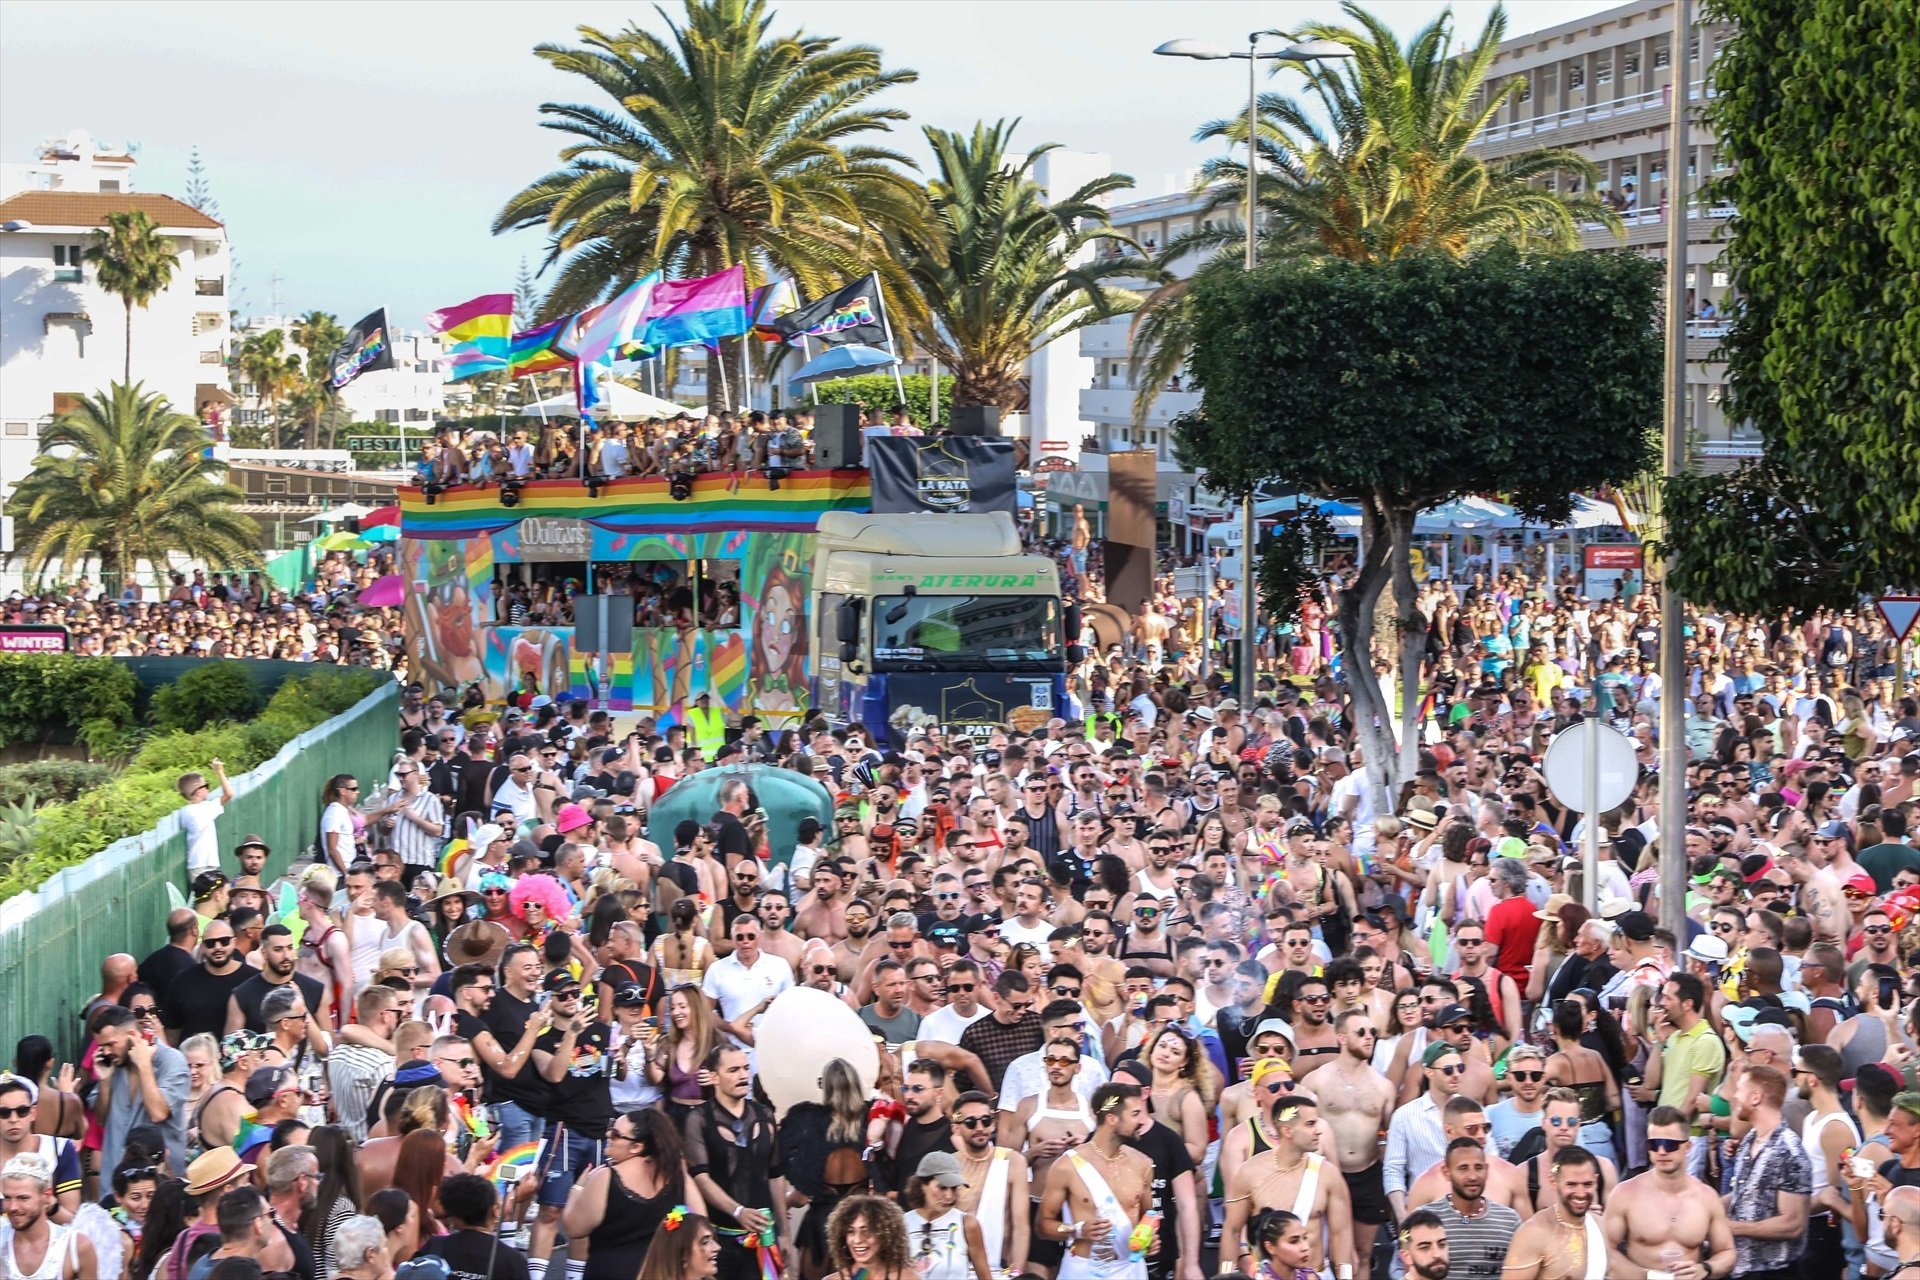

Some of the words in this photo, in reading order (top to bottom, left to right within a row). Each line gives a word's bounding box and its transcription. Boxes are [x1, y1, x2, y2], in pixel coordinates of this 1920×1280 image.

[918, 480, 935, 490] LA
[938, 480, 969, 490] PATA
[917, 574, 1037, 589] ATERURA
[1, 636, 65, 650] WINTER
[1035, 694, 1049, 708] 30
[966, 725, 994, 737] PAT
